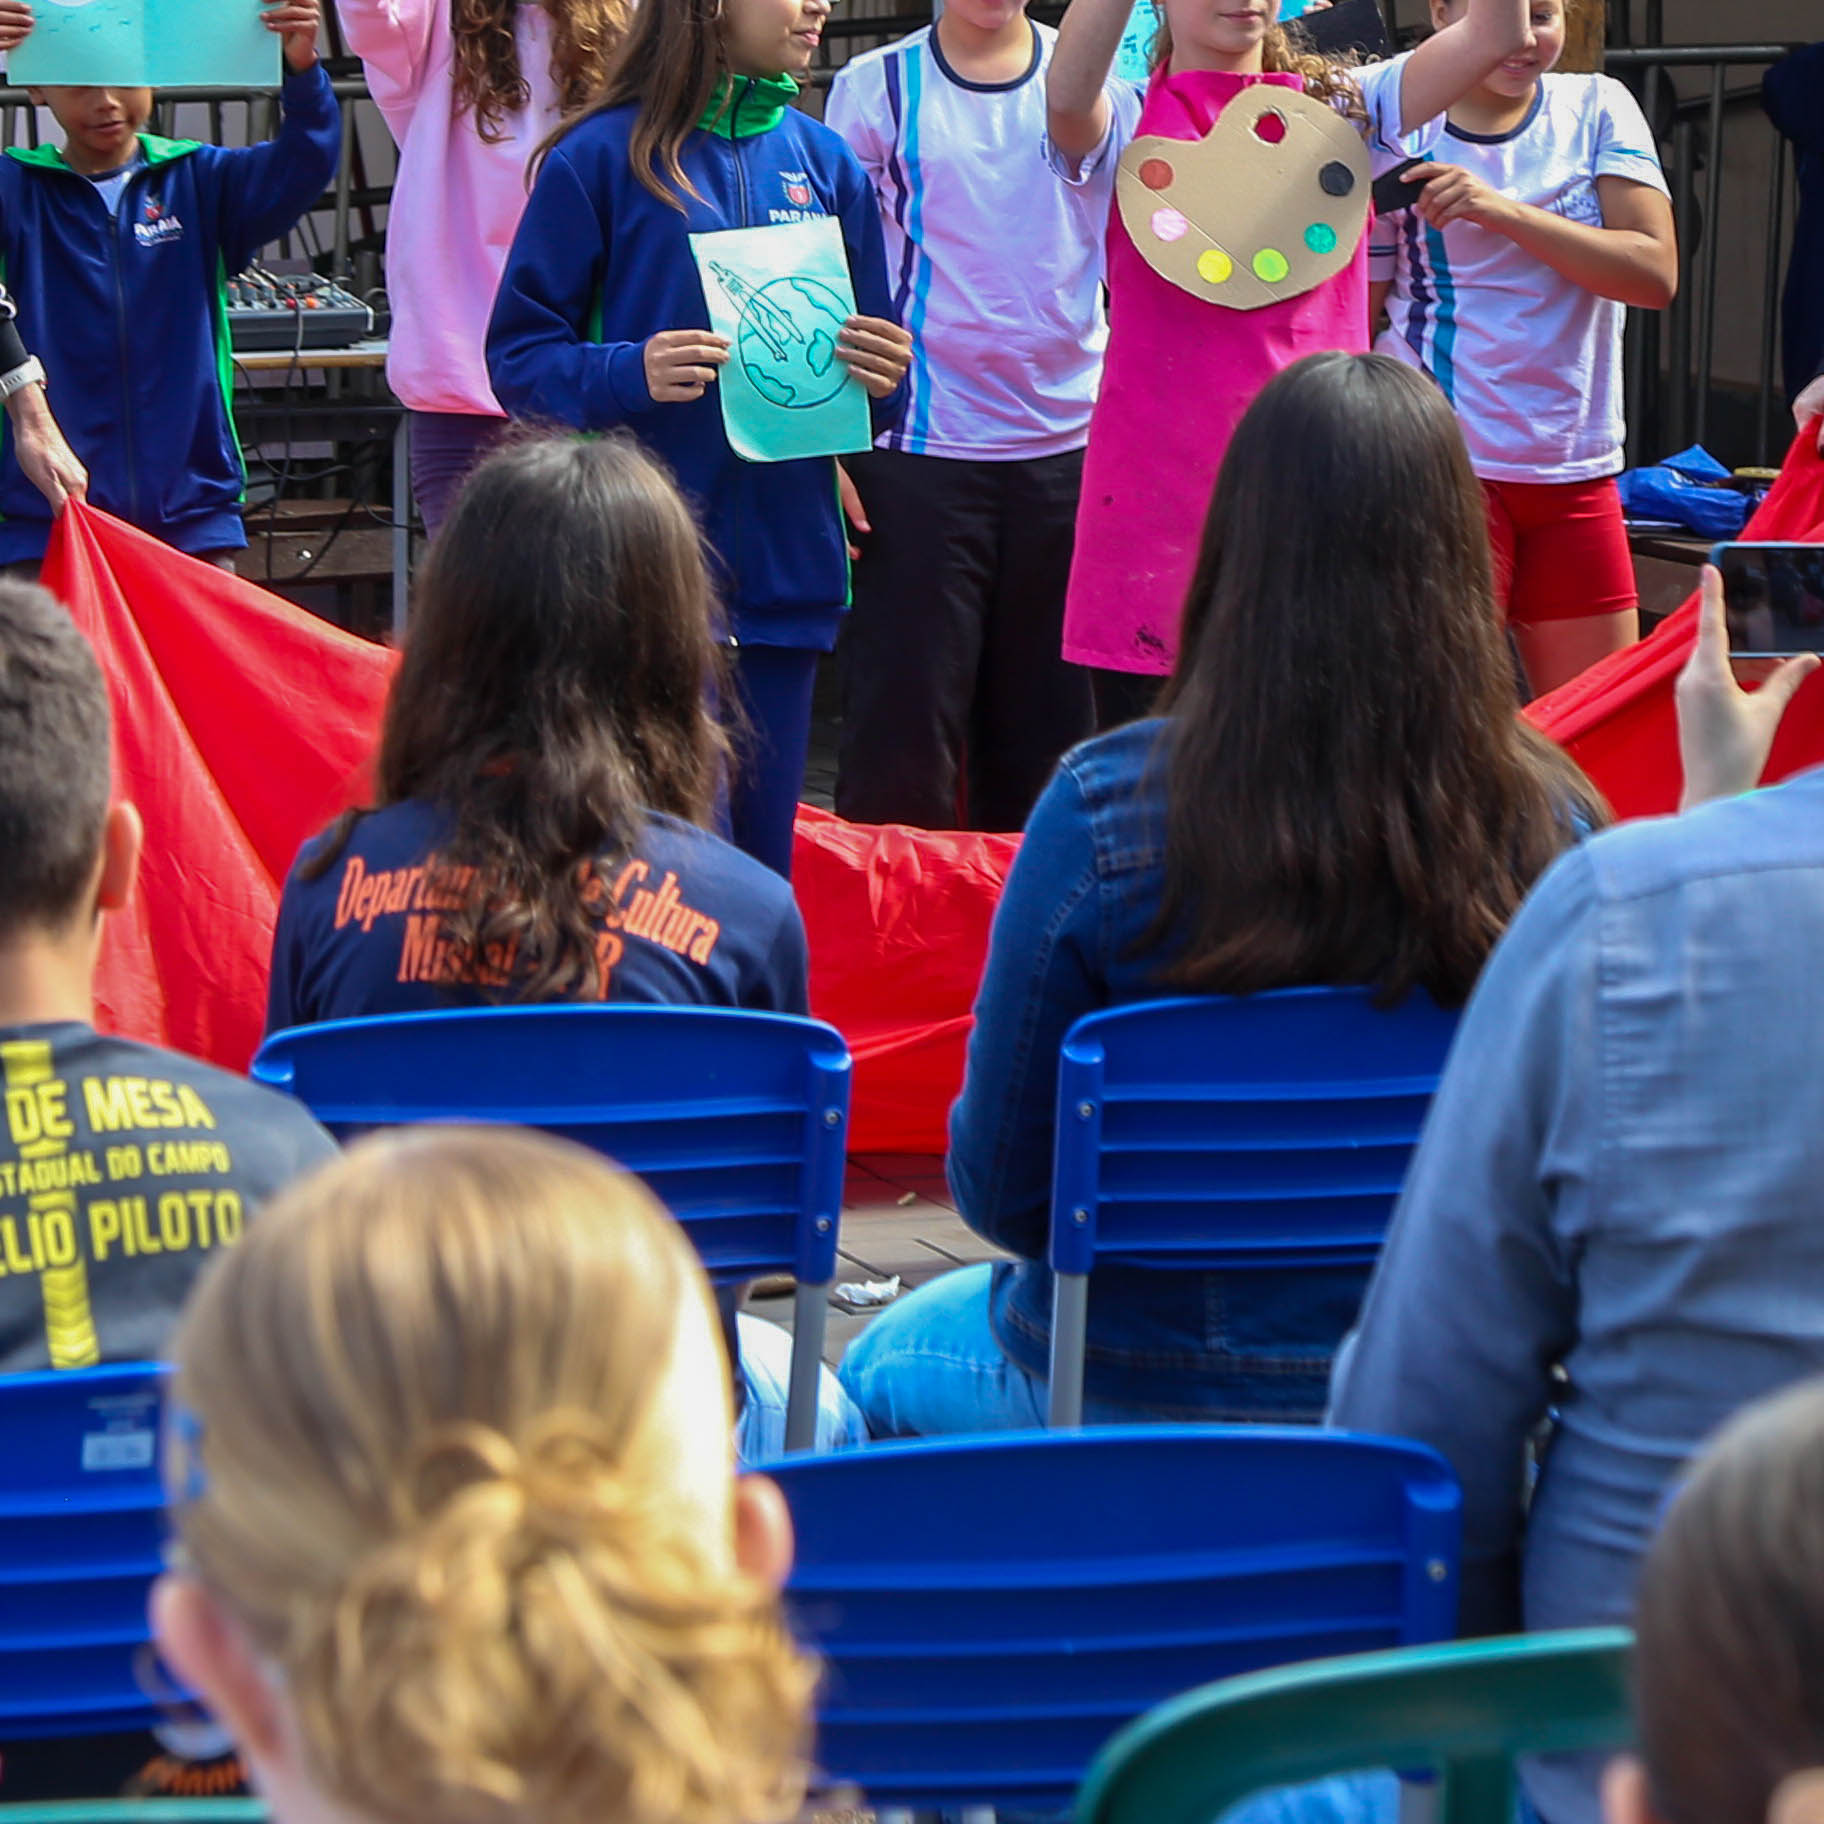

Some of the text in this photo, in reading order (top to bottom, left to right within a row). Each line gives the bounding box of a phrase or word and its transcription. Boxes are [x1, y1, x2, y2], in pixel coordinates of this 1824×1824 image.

[606, 858, 721, 966] Cultura
[5, 1080, 74, 1144] DE
[82, 1076, 216, 1133] MESA
[106, 1143, 143, 1181] DO
[147, 1140, 231, 1176] CAMPO
[87, 1189, 245, 1261] PILOTO
